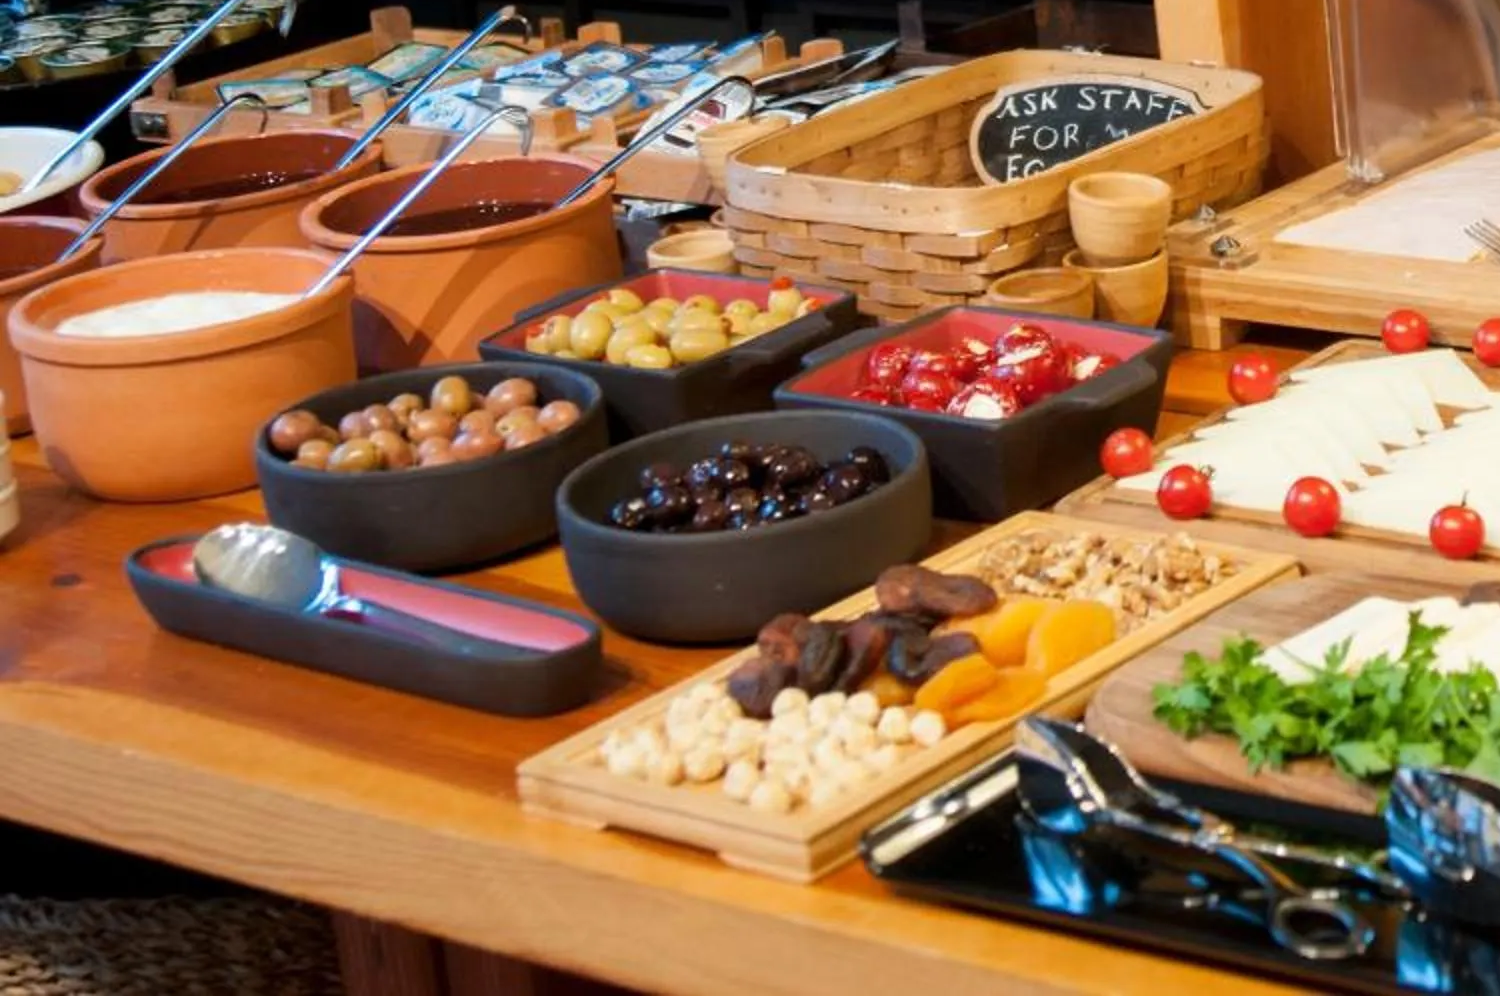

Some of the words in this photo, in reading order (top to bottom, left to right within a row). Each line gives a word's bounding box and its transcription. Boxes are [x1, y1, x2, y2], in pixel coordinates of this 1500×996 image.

[996, 87, 1060, 119] ASK
[1076, 86, 1192, 122] STAFF
[1009, 122, 1080, 151] FOR
